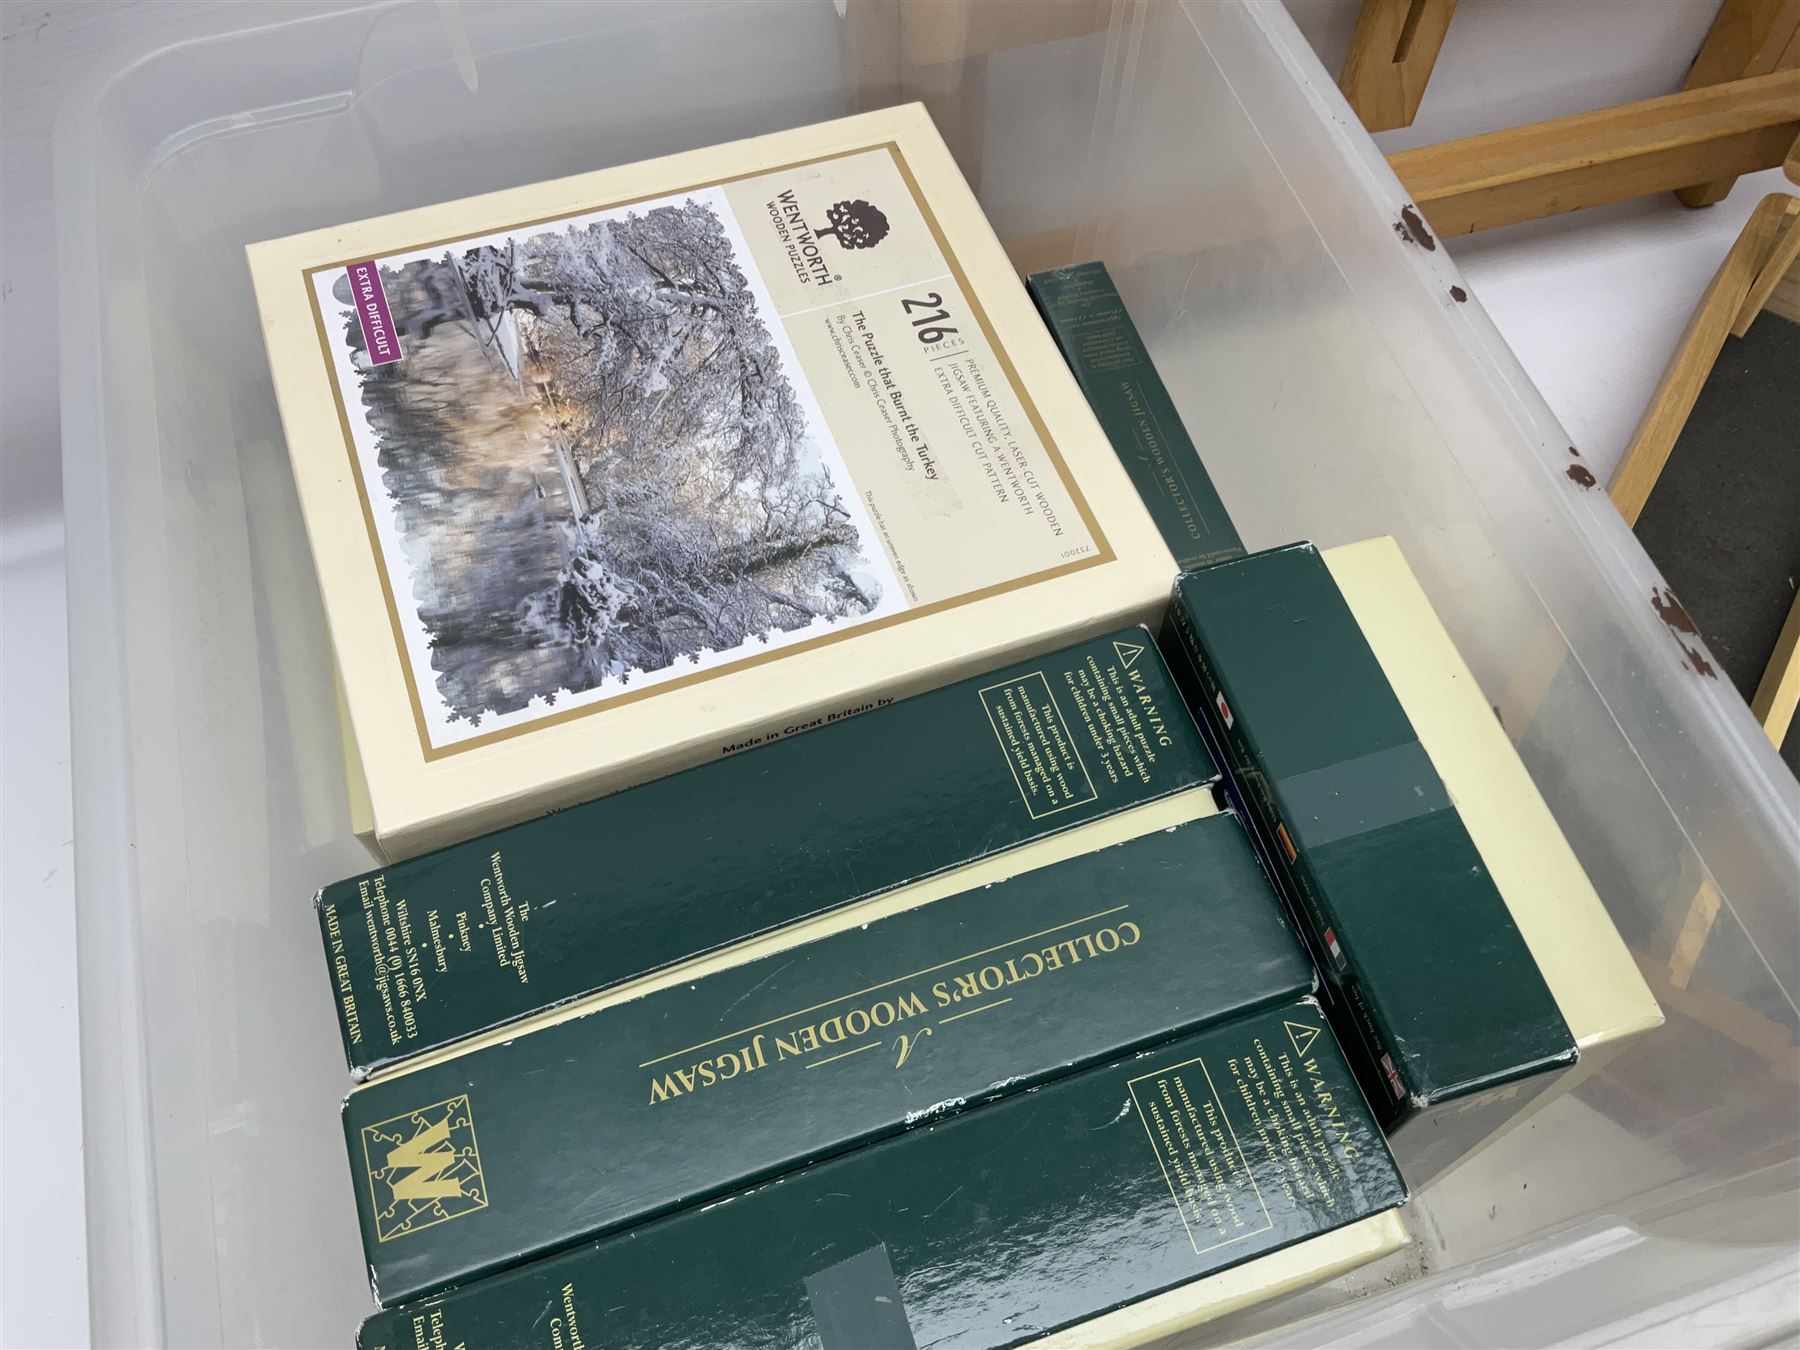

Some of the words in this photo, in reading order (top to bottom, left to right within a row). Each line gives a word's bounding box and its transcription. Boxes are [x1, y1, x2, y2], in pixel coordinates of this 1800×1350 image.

[765, 200, 792, 242] WOODEN
[784, 243, 811, 284] PUZZLES
[776, 188, 835, 286] WENTWORTH
[355, 266, 374, 301] EXTRA
[365, 302, 391, 355] DIFFICULT
[900, 291, 959, 352] 216
[922, 336, 965, 354] PIECES
[835, 313, 846, 324] By
[841, 324, 855, 345] Chris
[850, 343, 866, 369] Ceaser
[866, 377, 880, 398] Chris
[875, 397, 892, 423] Ceaser
[887, 423, 915, 471] Photography
[851, 309, 866, 331] The
[861, 331, 884, 365] Puzzle
[877, 366, 896, 390] that
[889, 390, 912, 422] Burnt
[904, 422, 919, 442] the
[915, 442, 939, 480] Turkey
[933, 366, 954, 395] EXTRA
[948, 395, 977, 438] DIFFICULT
[971, 440, 988, 459] CUT
[981, 456, 1009, 503] PATTERN
[946, 361, 971, 392] JIGSAW
[965, 393, 998, 444] FEATURING
[991, 445, 1001, 453] A
[996, 452, 1034, 515] WENTWORTH
[964, 358, 991, 398] PREMIUM
[1007, 440, 1040, 489] LASER-CUT
[1034, 490, 1064, 536] WOODEN
[863, 489, 873, 503] This
[877, 519, 886, 531] has
[895, 559, 906, 575] edge
[1059, 544, 1091, 559] 732001
[1085, 655, 1111, 701] containing
[721, 736, 762, 755] Made
[765, 730, 780, 742] in
[783, 718, 823, 735] Great
[825, 702, 873, 722] Britain
[1041, 702, 1054, 723] This
[1063, 670, 1074, 685] for
[1070, 685, 1091, 722] children
[1087, 723, 1104, 750] under
[1100, 758, 1118, 783] years
[1077, 668, 1090, 686] may
[1086, 687, 1096, 699] be
[1095, 707, 1116, 745] choking
[1112, 743, 1133, 777] hazard
[1106, 664, 1119, 685] This
[1115, 685, 1123, 694] is
[1119, 695, 1129, 707] an
[1125, 707, 1141, 731] adult
[1133, 731, 1155, 762] puzzle
[1107, 701, 1125, 725] small
[1127, 668, 1172, 746] WARNING
[995, 704, 1020, 746] sustained
[1010, 746, 1030, 769] yield
[1023, 768, 1038, 796] basis.
[1003, 687, 1017, 710] from
[1013, 710, 1030, 741] forests
[1026, 741, 1051, 783] managed
[1045, 783, 1055, 797] on
[1016, 685, 1050, 746] manufactured
[1044, 746, 1060, 772] using
[1056, 772, 1074, 799] wood
[1046, 723, 1071, 761] product
[1066, 761, 1075, 770] is
[1115, 726, 1135, 754] pieces
[1132, 754, 1150, 783] which
[358, 879, 374, 909] Email
[373, 873, 391, 926] Telephone
[489, 850, 511, 906] Wentworth
[323, 903, 341, 938] MADE
[395, 898, 412, 945] Wiltshire
[455, 910, 471, 951] Pinkney
[479, 877, 497, 925] Company
[491, 926, 511, 967] Limited
[503, 905, 520, 949] Wooden
[517, 900, 530, 921] The
[331, 938, 344, 954] IN
[384, 926, 399, 952] 0044
[385, 954, 402, 972] (0)
[404, 946, 421, 976] SN16
[426, 909, 447, 972] Malmesbury
[334, 955, 352, 992] GREAT
[365, 909, 402, 1045] wentworth@jigsaws.co.uk
[394, 971, 409, 998] 1666
[411, 976, 427, 1002] 0NX
[509, 949, 528, 983] Jigsaw
[342, 994, 362, 1044] BRITAIN
[399, 998, 418, 1038] 840033
[774, 991, 929, 1061] WOODEN
[648, 1034, 768, 1105] JIGSAW
[892, 1027, 932, 1069] A
[1276, 1052, 1295, 1075] This
[1243, 1055, 1261, 1081] may
[1255, 1080, 1269, 1095] be
[1262, 1096, 1272, 1106] a
[1267, 1106, 1295, 1155] choking
[1252, 1037, 1287, 1098] containing
[1281, 1098, 1302, 1131] small
[1293, 1131, 1319, 1169] pieces
[1289, 1077, 1300, 1089] is
[1294, 1090, 1307, 1105] an
[1201, 1099, 1220, 1127] This
[1227, 1057, 1242, 1077] for
[1235, 1076, 1264, 1126] children
[1257, 1127, 1279, 1162] under
[1301, 1057, 1360, 1162] WARNING
[1301, 1106, 1323, 1138] adult
[1147, 1099, 1178, 1155] sustained
[1168, 1155, 1191, 1186] yield
[1184, 1187, 1206, 1222] basis.
[1157, 1078, 1176, 1108] from
[1169, 1108, 1193, 1149] forests
[1187, 1149, 1217, 1206] managed
[1209, 1207, 1223, 1224] on
[1218, 1226, 1227, 1235] a
[1173, 1074, 1215, 1155] manufactured
[1208, 1157, 1229, 1191] using
[1222, 1192, 1245, 1227] wood
[1210, 1126, 1241, 1175] product
